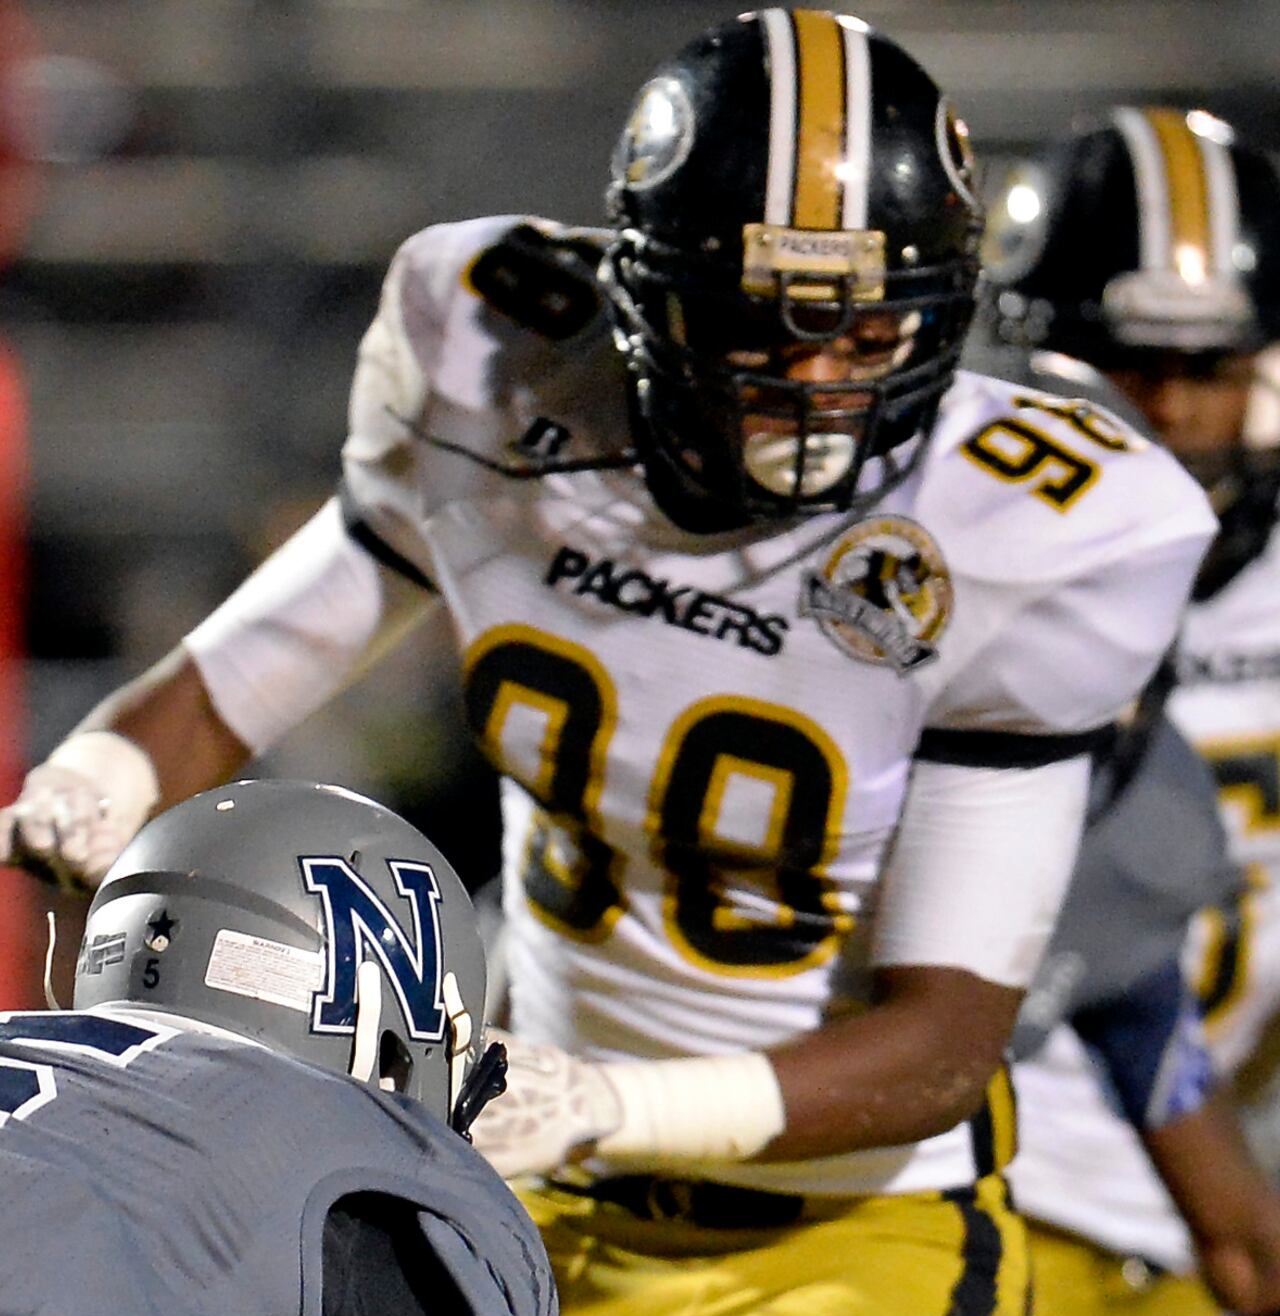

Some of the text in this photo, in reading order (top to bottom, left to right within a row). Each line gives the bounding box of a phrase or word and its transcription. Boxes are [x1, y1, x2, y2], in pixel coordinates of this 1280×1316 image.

[547, 548, 790, 658] PACKERS
[463, 622, 856, 979] 98
[142, 956, 161, 990] 5
[297, 855, 448, 1043] N
